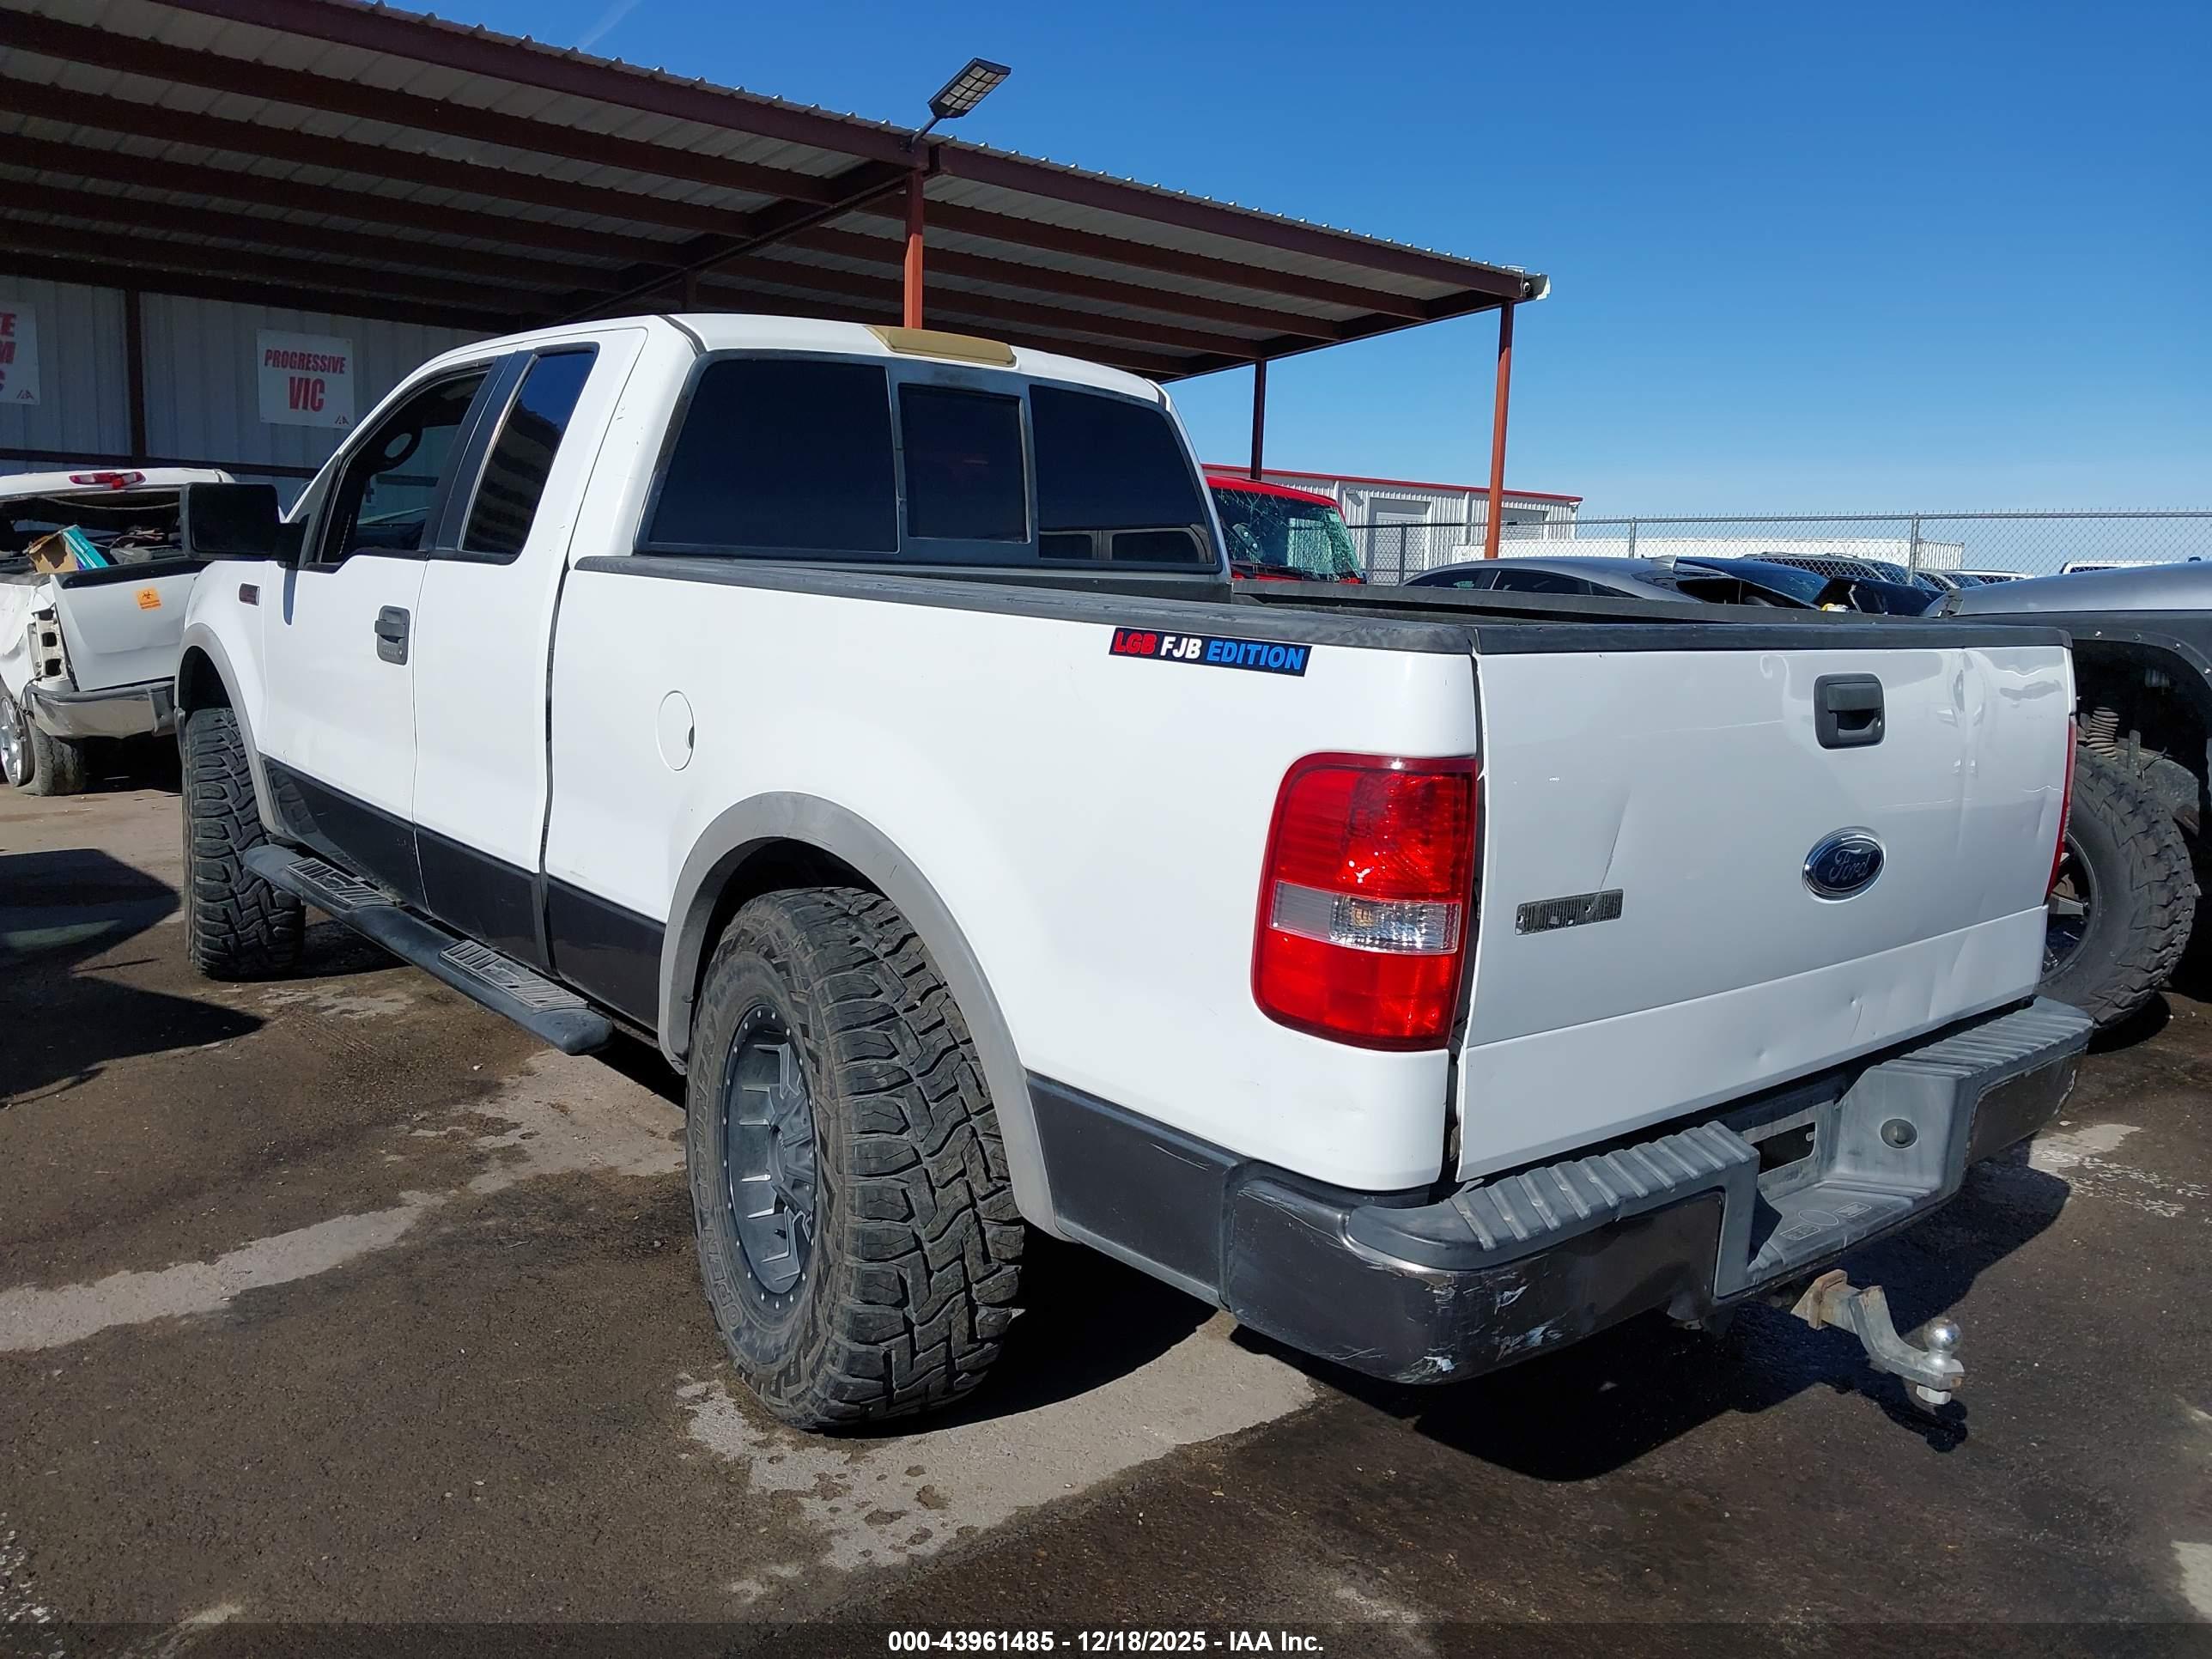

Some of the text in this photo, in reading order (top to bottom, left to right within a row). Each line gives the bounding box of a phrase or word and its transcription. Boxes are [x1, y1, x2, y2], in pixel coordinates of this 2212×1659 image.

[264, 349, 346, 374] PROGRESSIVE
[289, 376, 325, 412] VIC
[1114, 631, 1304, 670] LGB FJB EDITION
[1828, 848, 1872, 883] Ford
